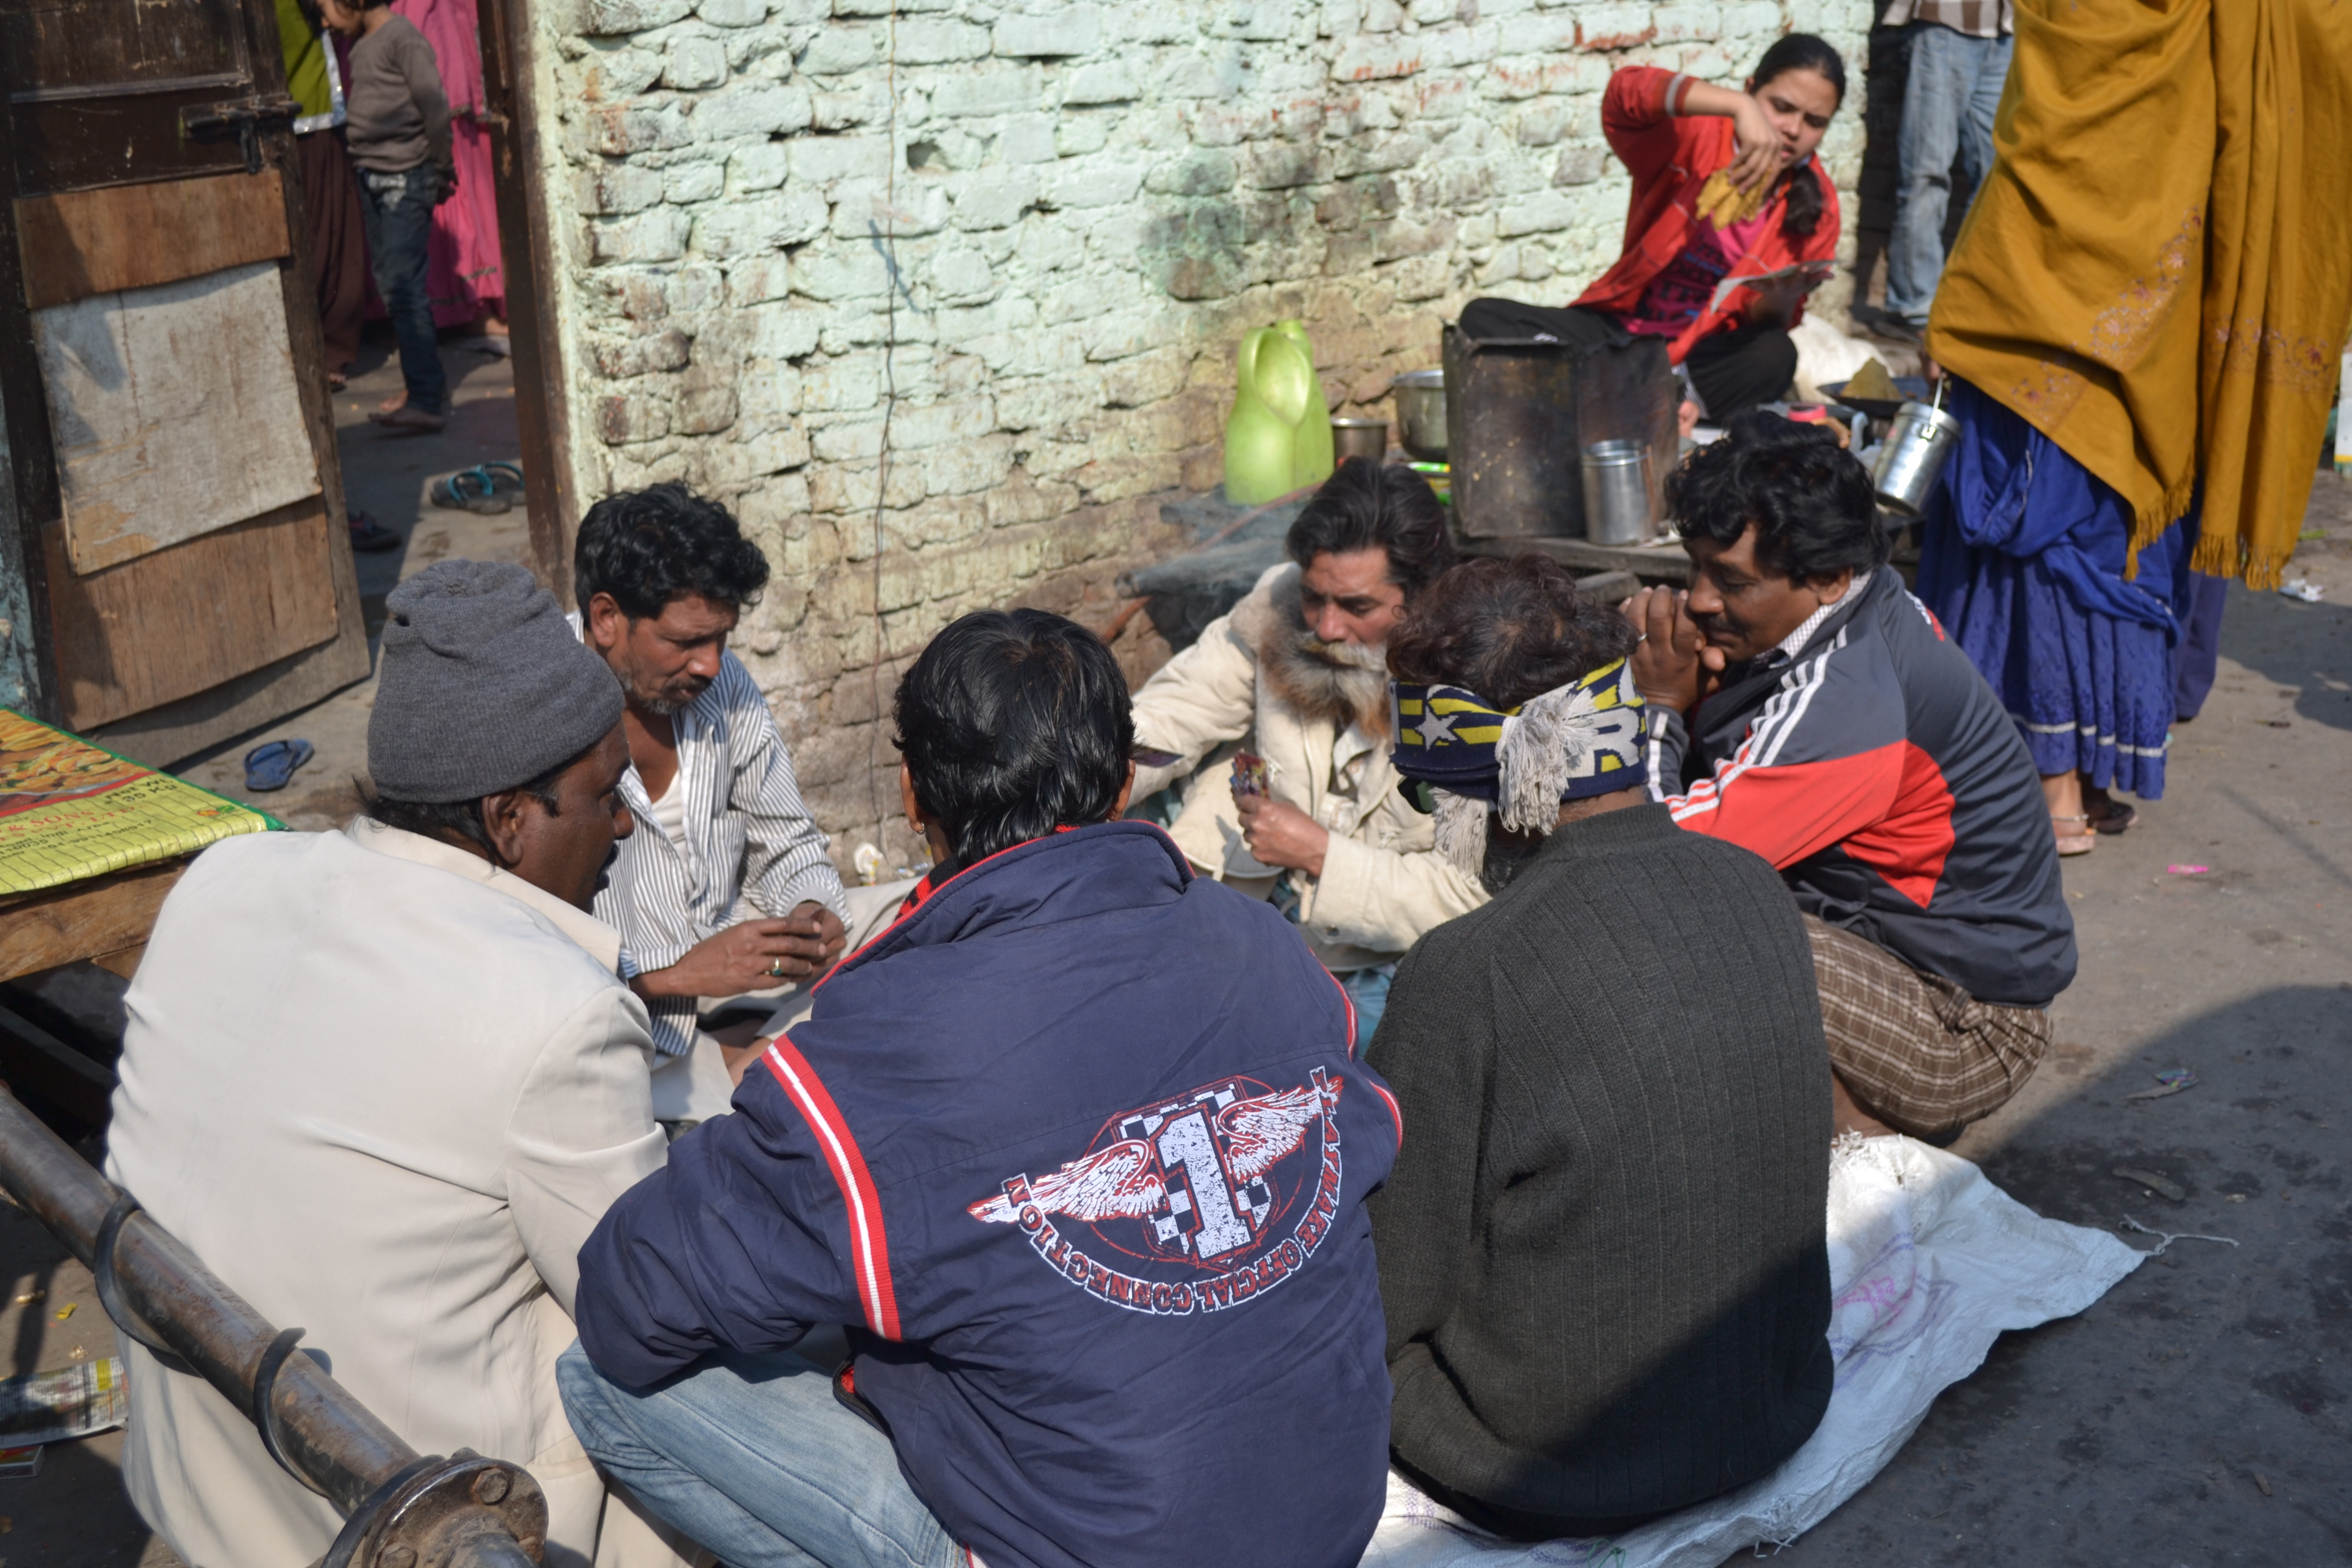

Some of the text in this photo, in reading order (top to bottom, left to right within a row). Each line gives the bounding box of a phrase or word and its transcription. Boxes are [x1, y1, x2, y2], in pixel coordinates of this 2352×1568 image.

[30, 810, 94, 827] SONS
[1001, 1172, 1195, 1315] CONNECTION
[1156, 1112, 1251, 1260] 1
